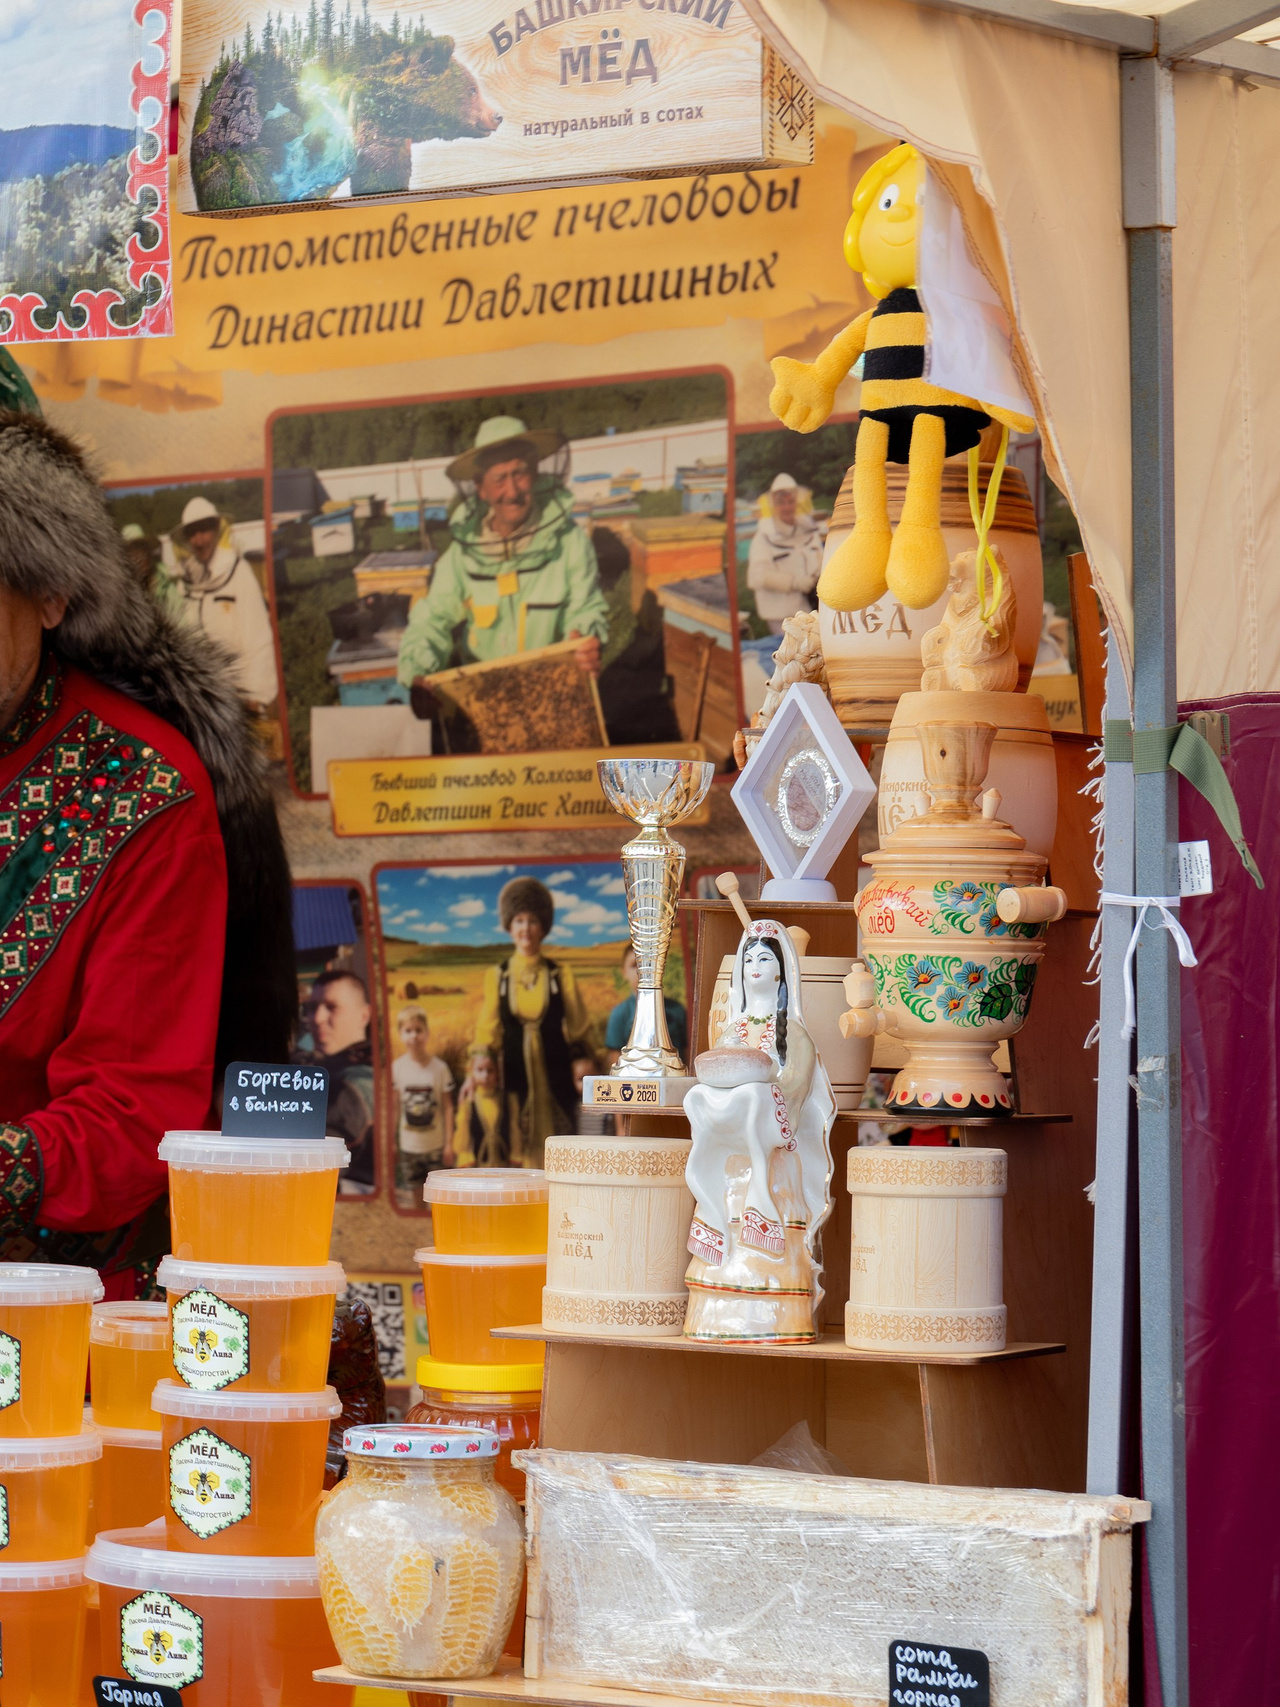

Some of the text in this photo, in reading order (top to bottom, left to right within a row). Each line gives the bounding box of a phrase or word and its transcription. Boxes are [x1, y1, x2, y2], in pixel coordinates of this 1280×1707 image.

[558, 28, 659, 87] МЁД
[523, 105, 705, 138] натуральный в сотах
[180, 170, 802, 284] Потомственные пчеловоды
[207, 251, 779, 350] Династии Давлетшиных
[371, 764, 594, 793] Бывший пчеловод Колхоза
[373, 801, 493, 825] Давлетшин
[498, 796, 548, 820] Раис
[237, 1069, 325, 1096] Бортевой
[229, 1095, 314, 1113] в банках
[636, 1091, 657, 1102] 2020
[562, 1242, 594, 1260] МЁД
[190, 1301, 217, 1317] МЁД
[194, 1316, 239, 1331] Давлетшиных
[212, 1350, 233, 1358] Липа
[181, 1363, 230, 1377] Башкортостан
[189, 1442, 219, 1460] МЁД
[194, 1457, 241, 1472] Давлетшиных
[173, 1484, 235, 1499] Горная Липа
[180, 1503, 233, 1519] Башкортостан
[143, 1601, 172, 1618] МЁД
[148, 1617, 193, 1632] Давлетшиных
[126, 1644, 188, 1660] Горная Липа
[895, 1645, 958, 1671] сота
[134, 1664, 186, 1679] Башкортостан
[100, 1679, 164, 1707] Горная
